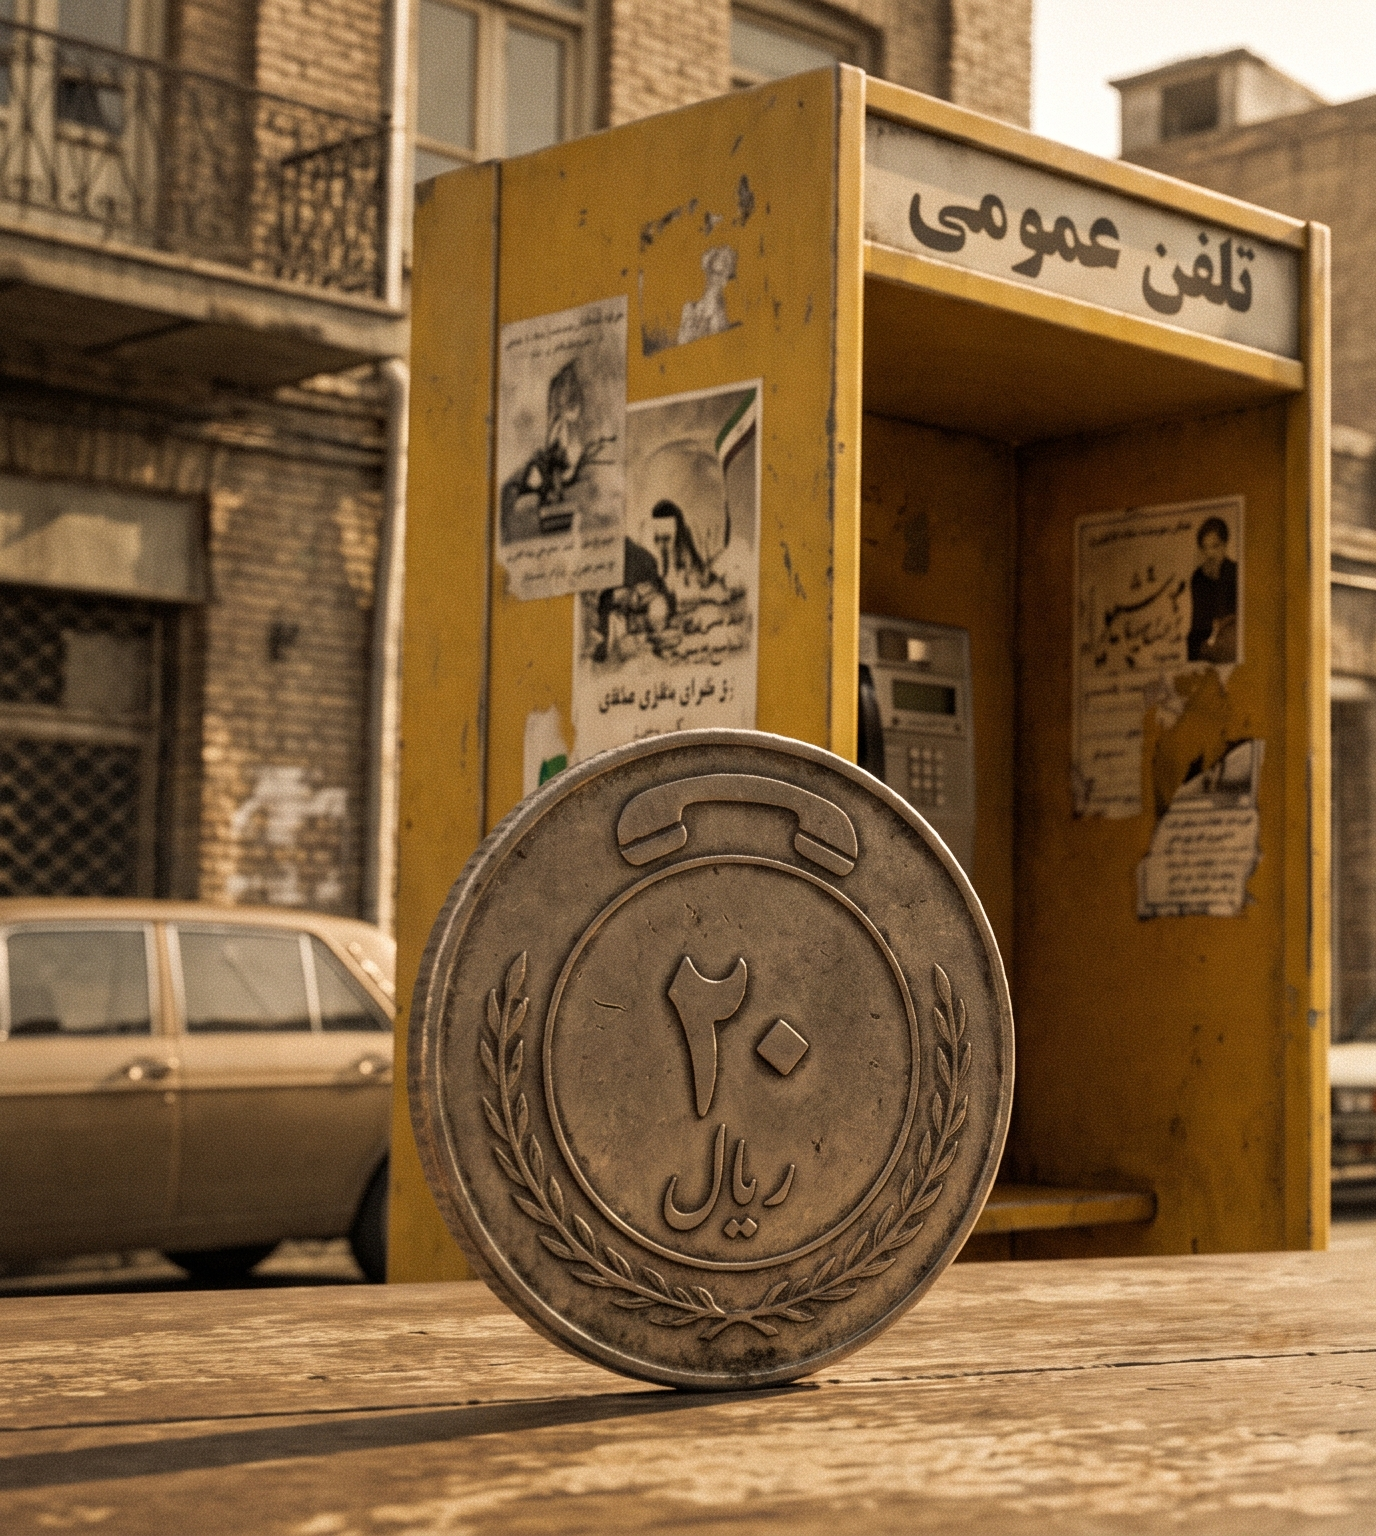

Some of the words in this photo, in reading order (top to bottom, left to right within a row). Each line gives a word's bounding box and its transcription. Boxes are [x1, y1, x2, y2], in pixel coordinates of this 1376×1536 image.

[909, 192, 1121, 279] عمومی
[1141, 231, 1256, 316] تلفن
[667, 956, 810, 1118] ۲۰
[663, 1123, 796, 1239] ریال
